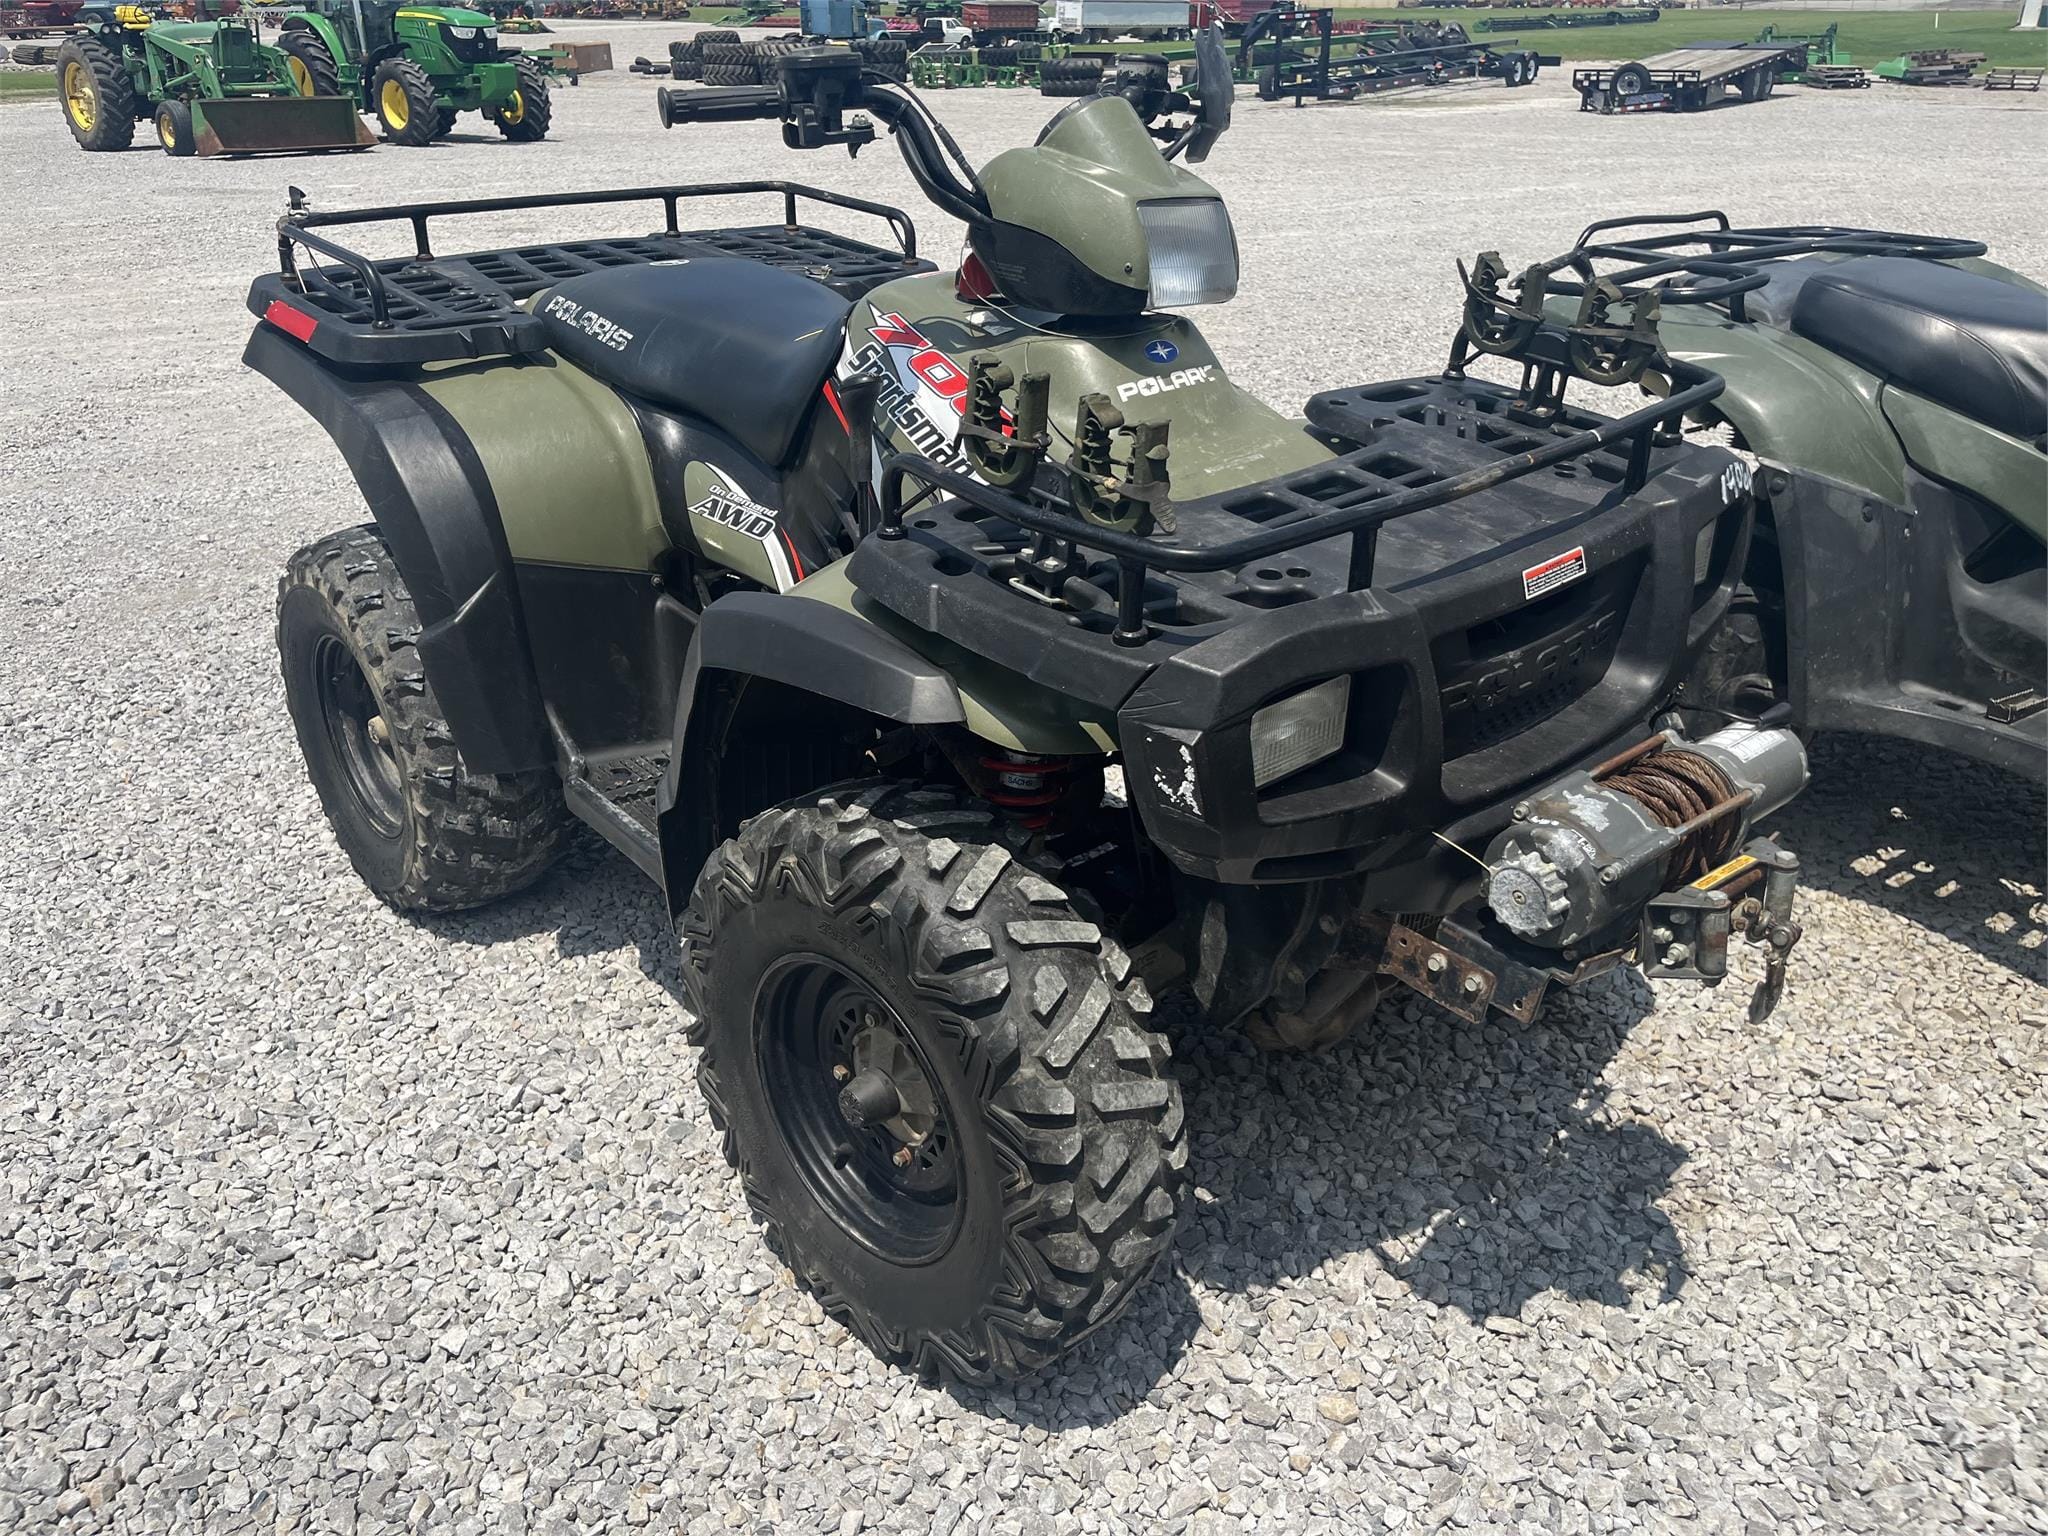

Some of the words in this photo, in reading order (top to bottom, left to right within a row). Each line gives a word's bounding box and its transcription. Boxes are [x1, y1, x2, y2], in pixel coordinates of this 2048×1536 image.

[544, 295, 634, 351] POLARIS
[688, 495, 776, 541] AWD
[708, 484, 727, 497] On
[726, 491, 779, 518] Demand
